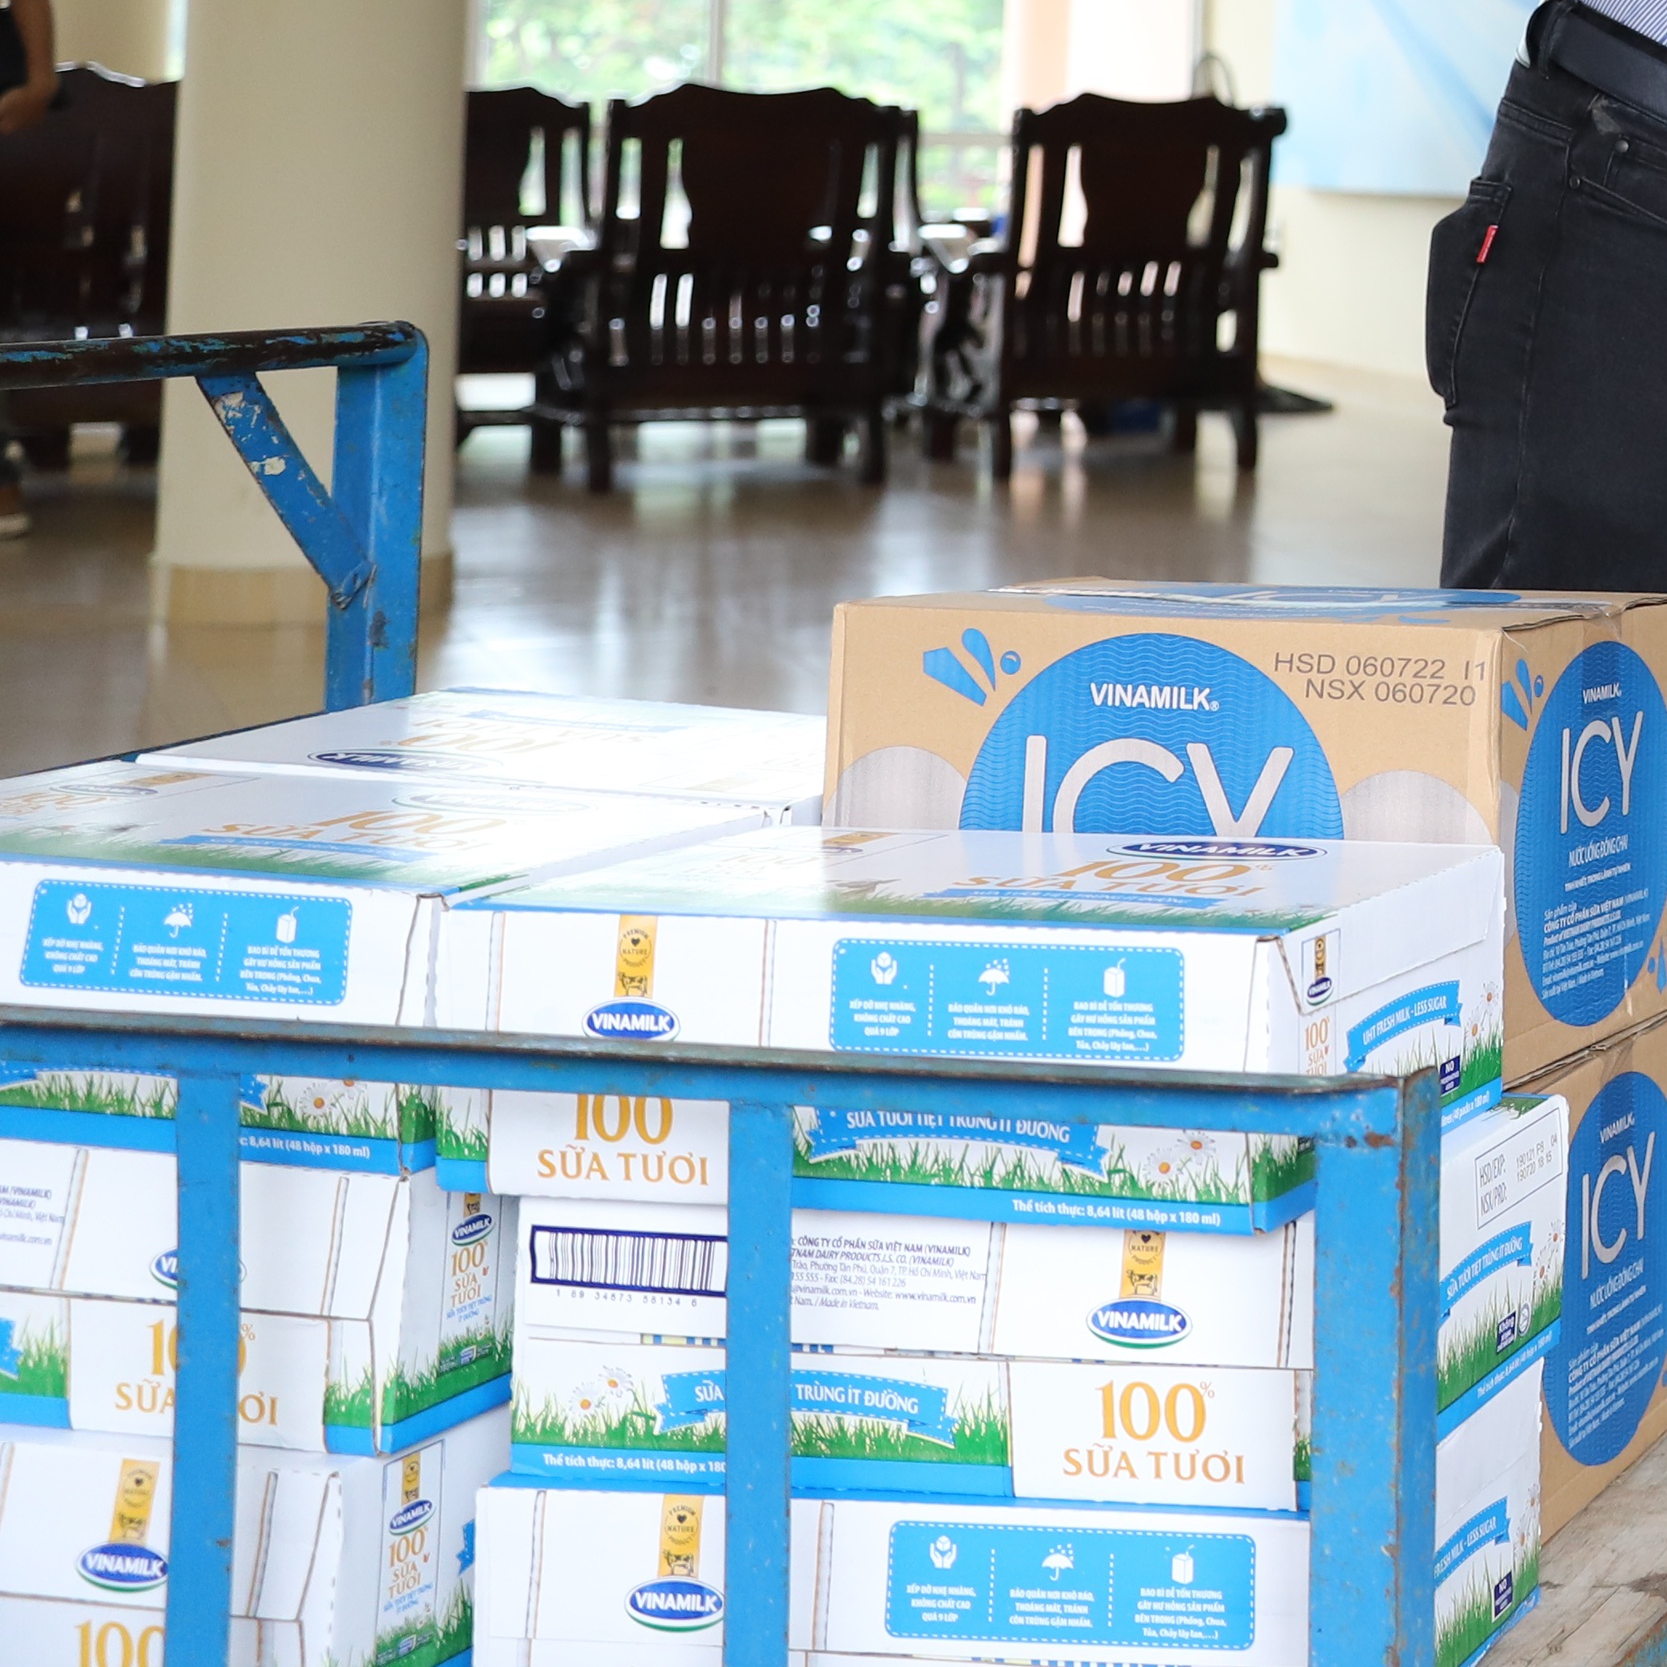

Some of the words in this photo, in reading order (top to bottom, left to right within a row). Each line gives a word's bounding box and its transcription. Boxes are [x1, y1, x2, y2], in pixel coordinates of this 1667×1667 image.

[1274, 651, 1335, 676] HSD
[1345, 655, 1446, 680] 060722
[1305, 678, 1366, 701] NSX
[1374, 680, 1476, 706] 060720
[1560, 710, 1645, 835] ICY
[590, 1011, 671, 1033] VINAMILK
[1581, 1131, 1655, 1280] ICY
[1093, 1306, 1184, 1335] VINAMILK
[1063, 1444, 1137, 1482] SỮA
[1151, 1450, 1245, 1485] TƯƠI
[633, 1591, 718, 1616] VINAMILK
